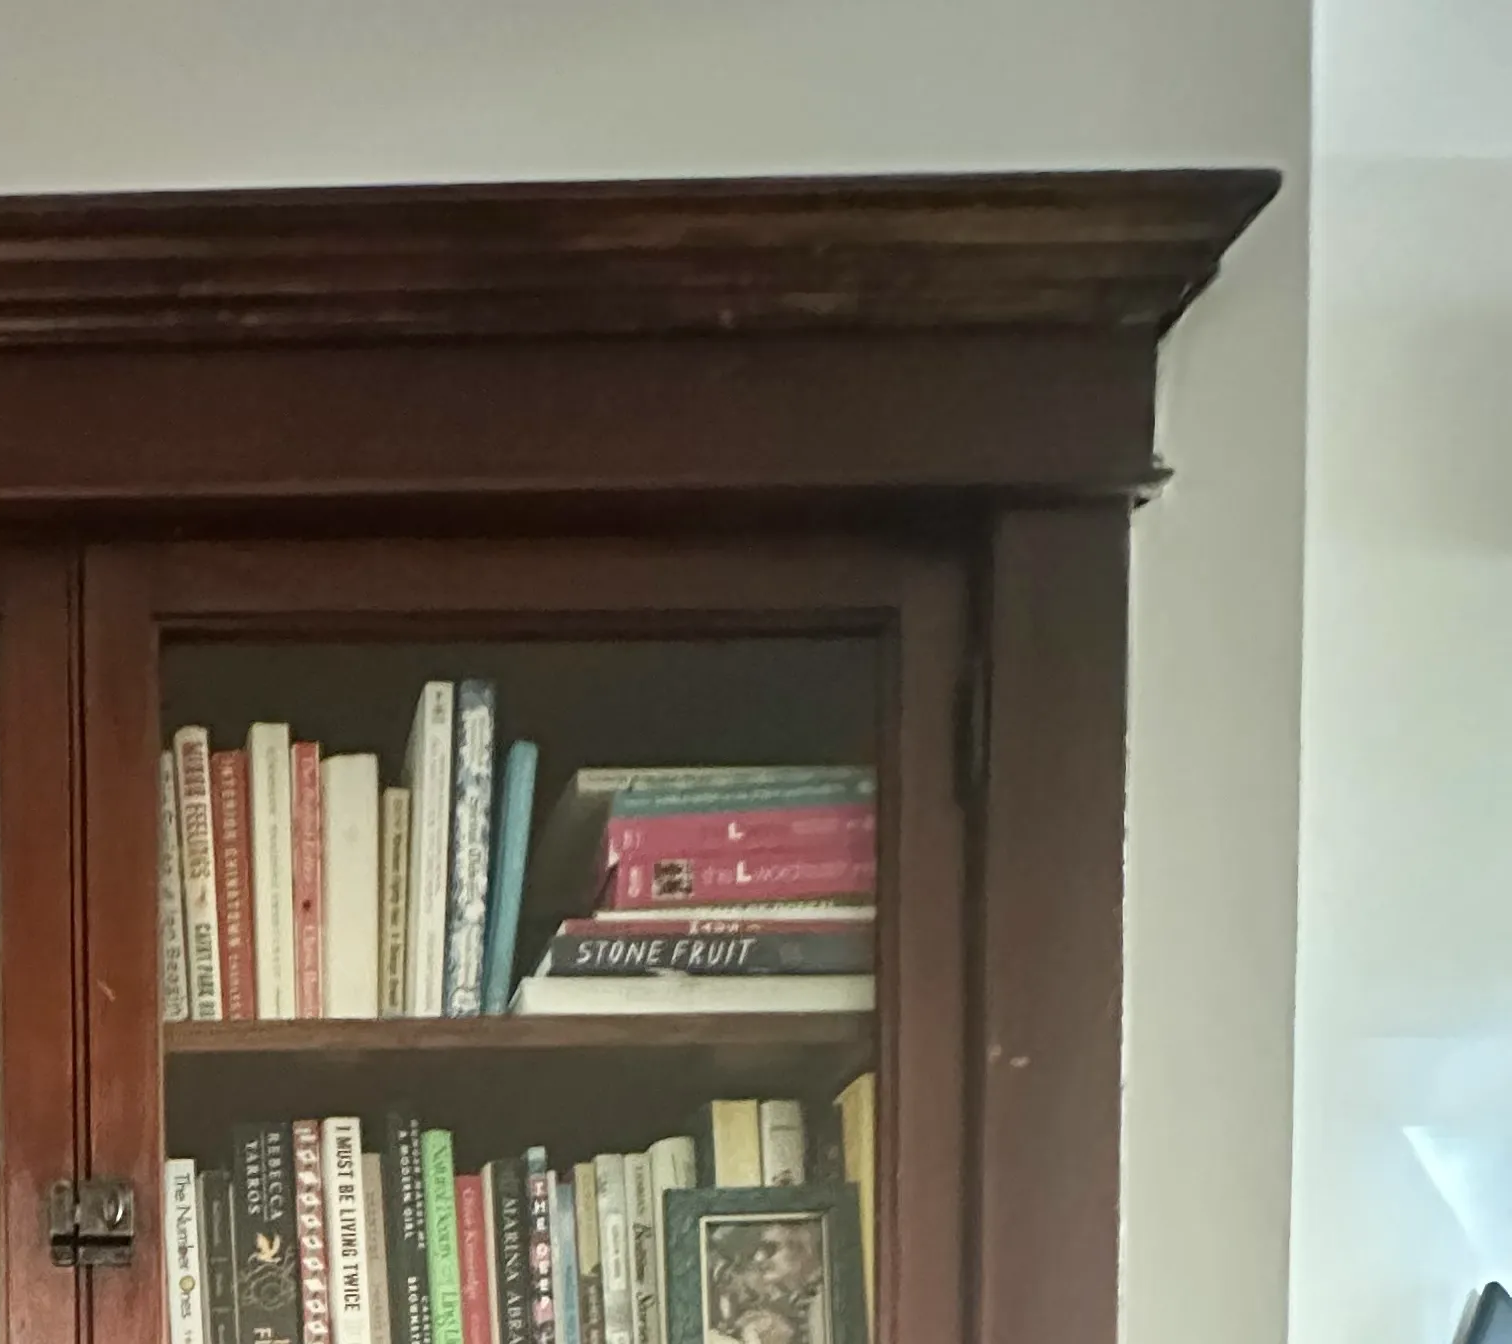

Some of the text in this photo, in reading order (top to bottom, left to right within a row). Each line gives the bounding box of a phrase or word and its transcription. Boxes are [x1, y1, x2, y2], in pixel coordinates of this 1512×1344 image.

[186, 803, 211, 880] FEELINGS
[223, 847, 242, 949] CHINATOWN
[575, 937, 758, 967] STONE FRUIT
[245, 1141, 261, 1216] YARROS
[268, 1132, 284, 1220] REBECCA
[336, 1136, 354, 1180] MUST
[399, 1144, 412, 1201] MODERN
[173, 1173, 191, 1202] The
[338, 1185, 356, 1204] BE
[175, 1206, 194, 1271] Number
[339, 1208, 358, 1257] LIVING
[402, 1207, 414, 1240] GIRL
[502, 1197, 521, 1282] MARINA
[178, 1275, 197, 1319] Ones
[343, 1263, 361, 1311] TWICE
